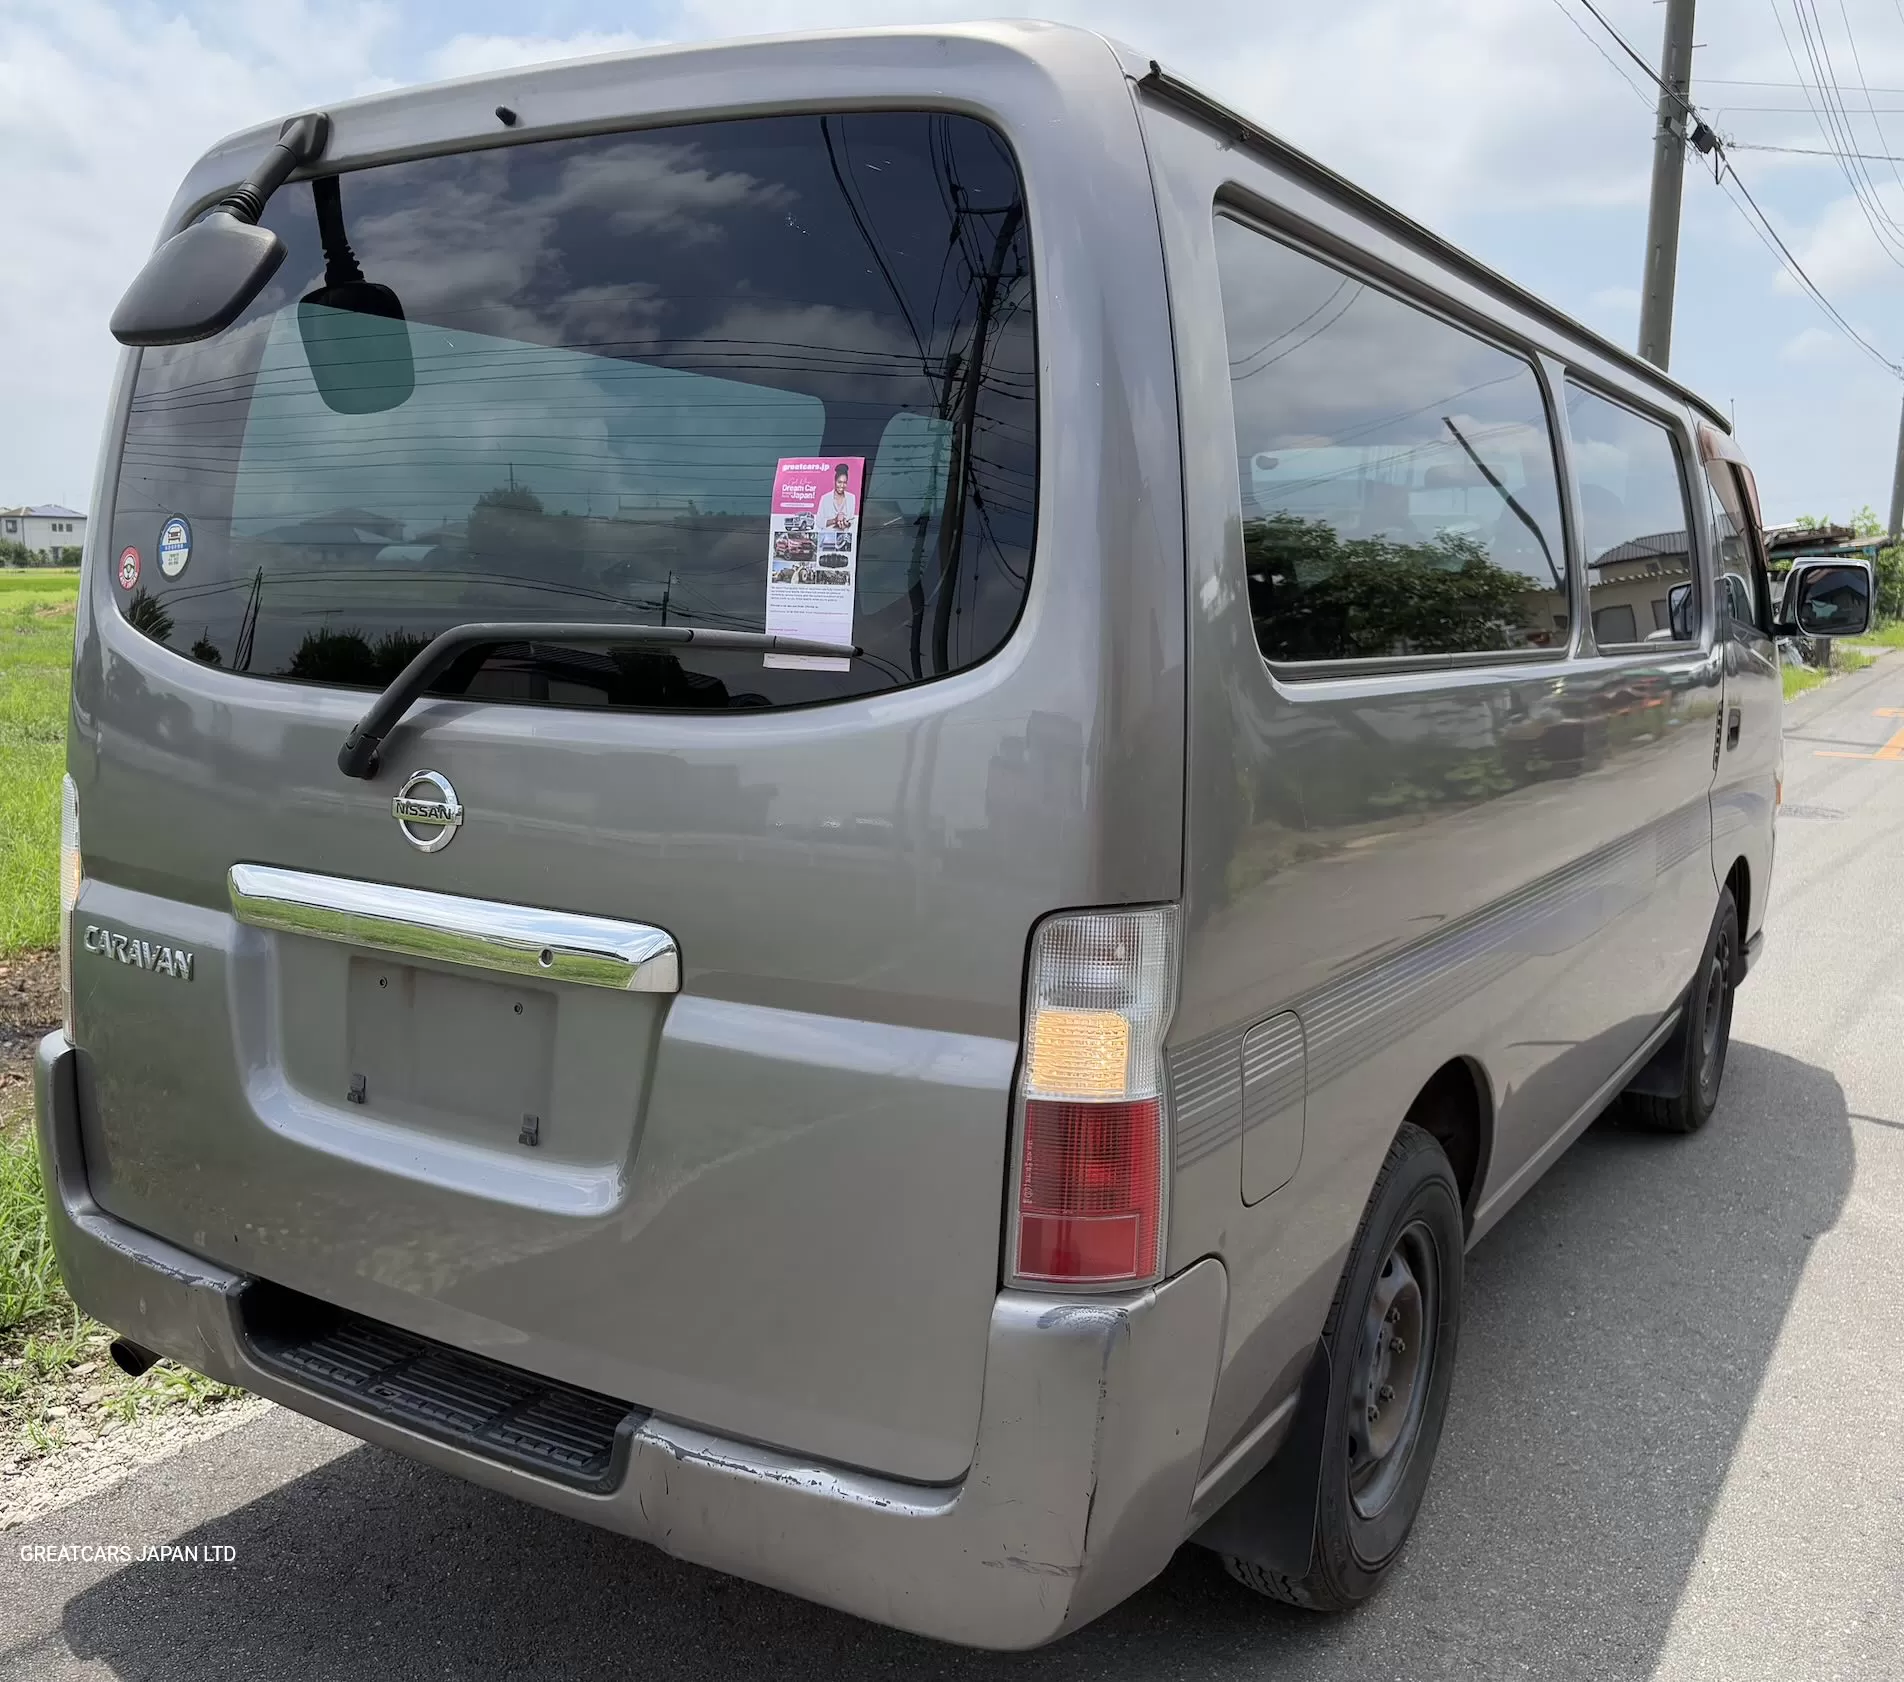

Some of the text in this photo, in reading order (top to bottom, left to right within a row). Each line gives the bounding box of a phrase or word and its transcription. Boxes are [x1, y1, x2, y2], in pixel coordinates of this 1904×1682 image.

[782, 463, 830, 472] greatcars.jp
[782, 484, 817, 492] Dream Car
[791, 492, 816, 501] Japan!
[395, 799, 452, 820] NISSAN
[83, 924, 194, 982] CARAVAN
